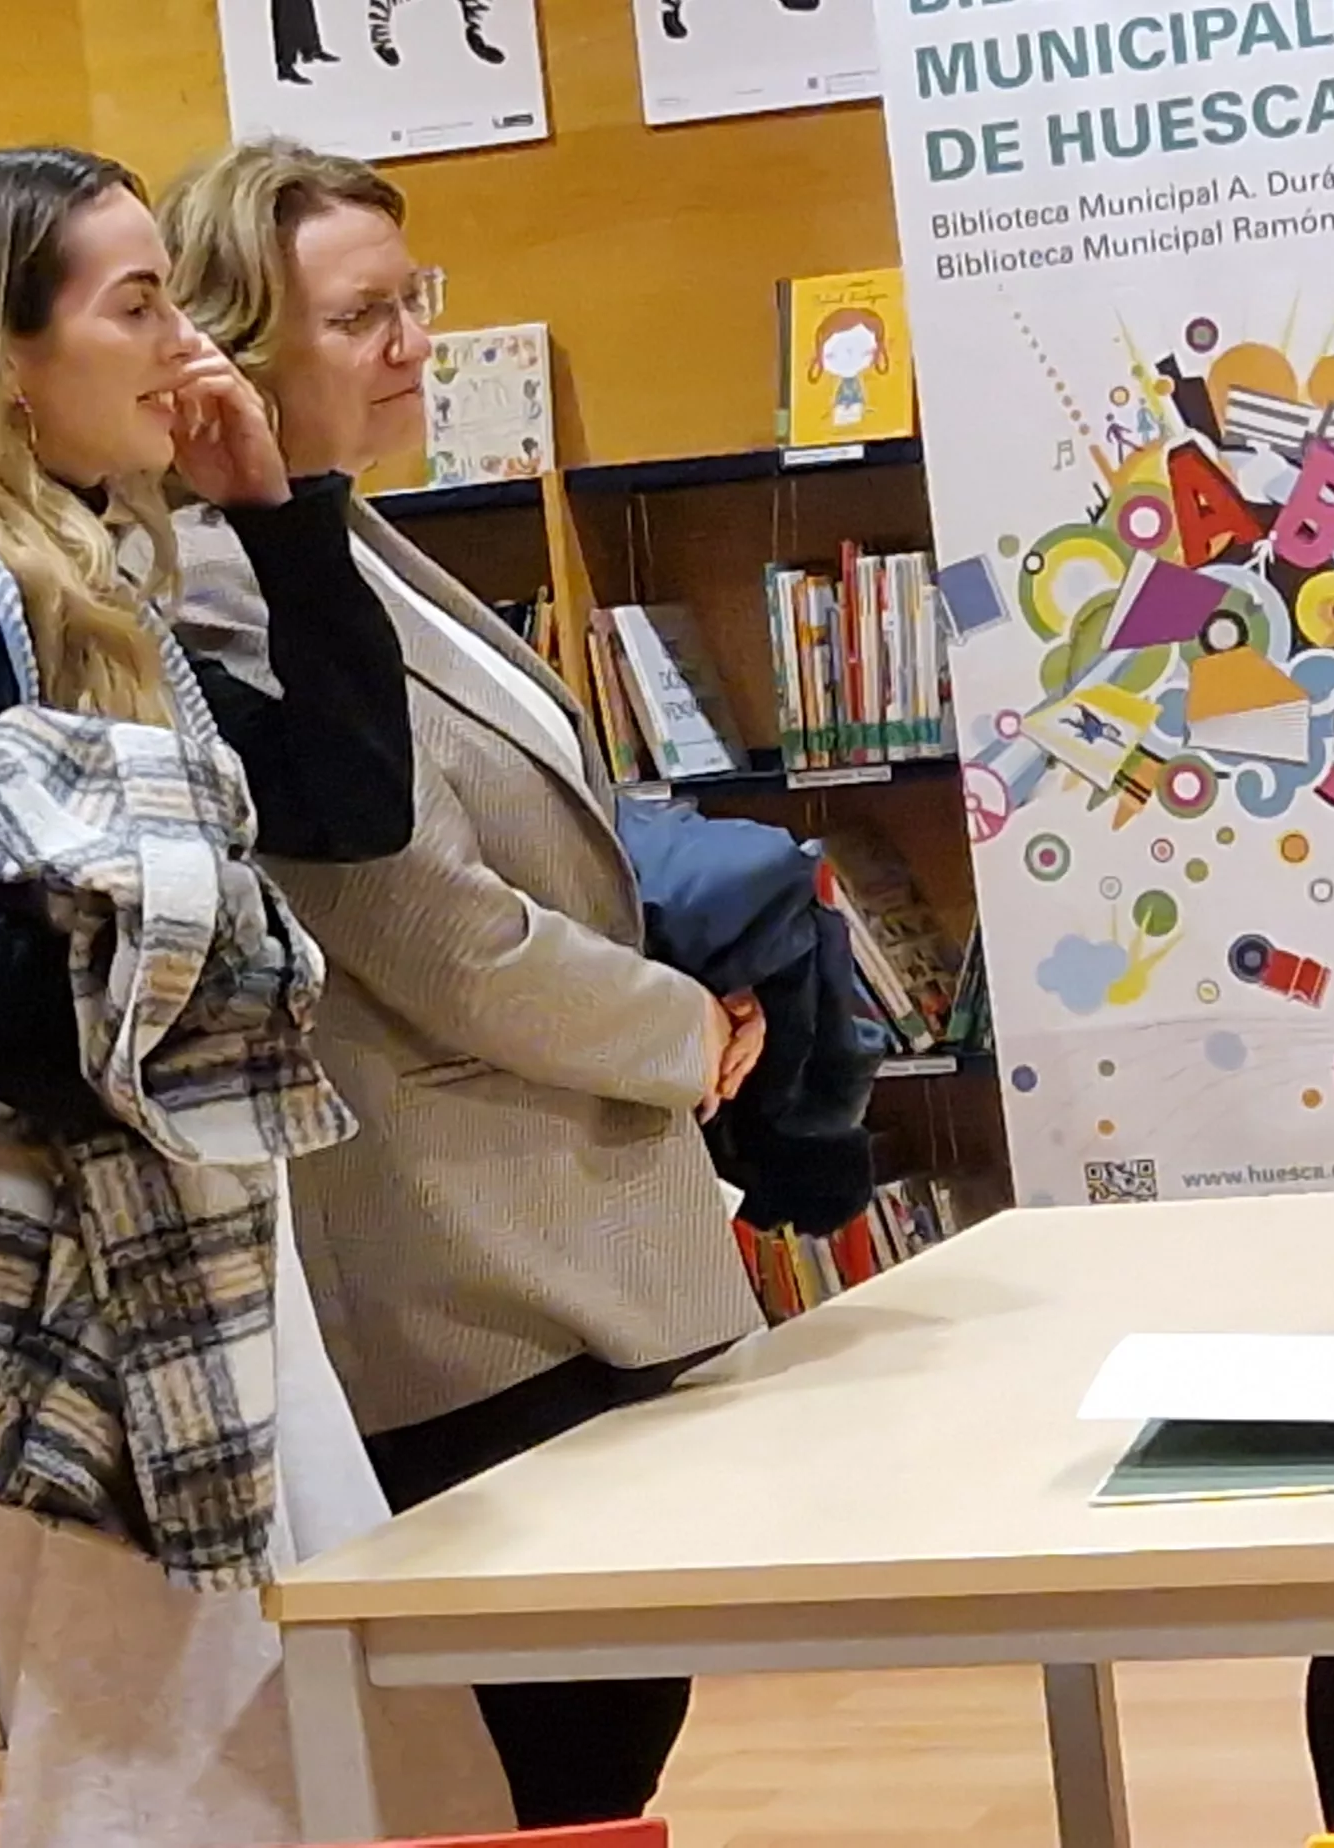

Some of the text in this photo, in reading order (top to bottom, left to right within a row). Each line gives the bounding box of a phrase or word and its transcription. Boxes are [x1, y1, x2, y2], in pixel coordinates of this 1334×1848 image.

[926, 118, 1024, 182] DE
[931, 204, 1070, 239] Biblioteca
[1079, 178, 1220, 222] Municipal
[1228, 175, 1258, 201] A.
[936, 249, 1074, 281] Biblioteca
[1083, 219, 1224, 261] Municipal
